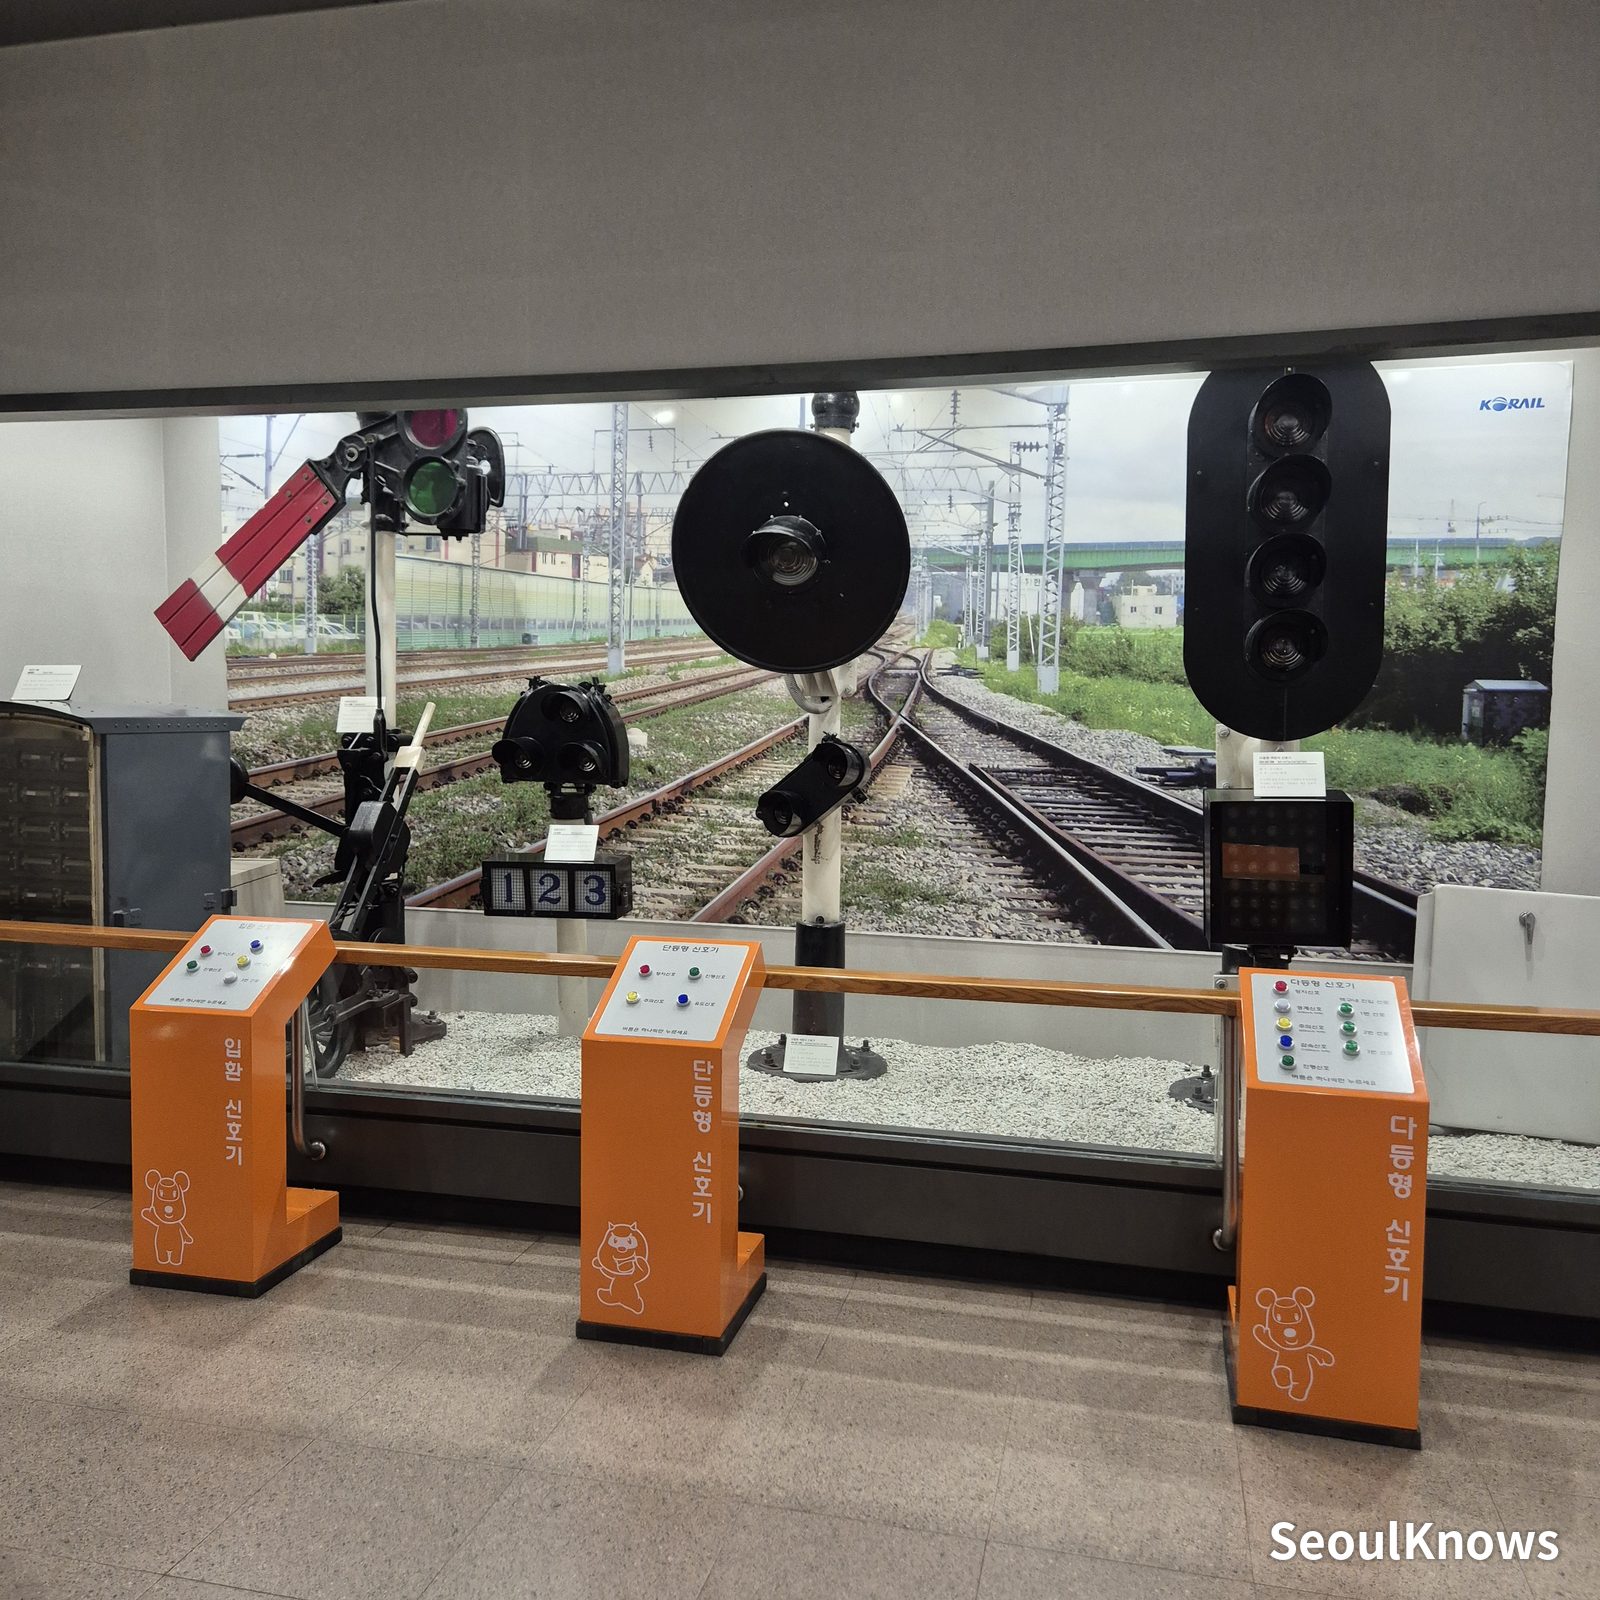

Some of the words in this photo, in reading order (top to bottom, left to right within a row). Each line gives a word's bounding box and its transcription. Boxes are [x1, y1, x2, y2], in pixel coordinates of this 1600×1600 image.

[1480, 397, 1545, 411] KORAIL
[504, 872, 513, 903] 1
[538, 873, 561, 904] 2
[583, 875, 606, 905] 3
[662, 944, 689, 952] 단등형
[1290, 978, 1320, 987] 다등형
[1325, 980, 1355, 988] 신호기
[224, 1037, 243, 1081] 입환
[693, 1059, 714, 1133] 단등형
[225, 1099, 243, 1166] 신호기
[1387, 1115, 1417, 1199] 다등형
[692, 1151, 712, 1224] 신호기
[1384, 1218, 1411, 1301] 신호기
